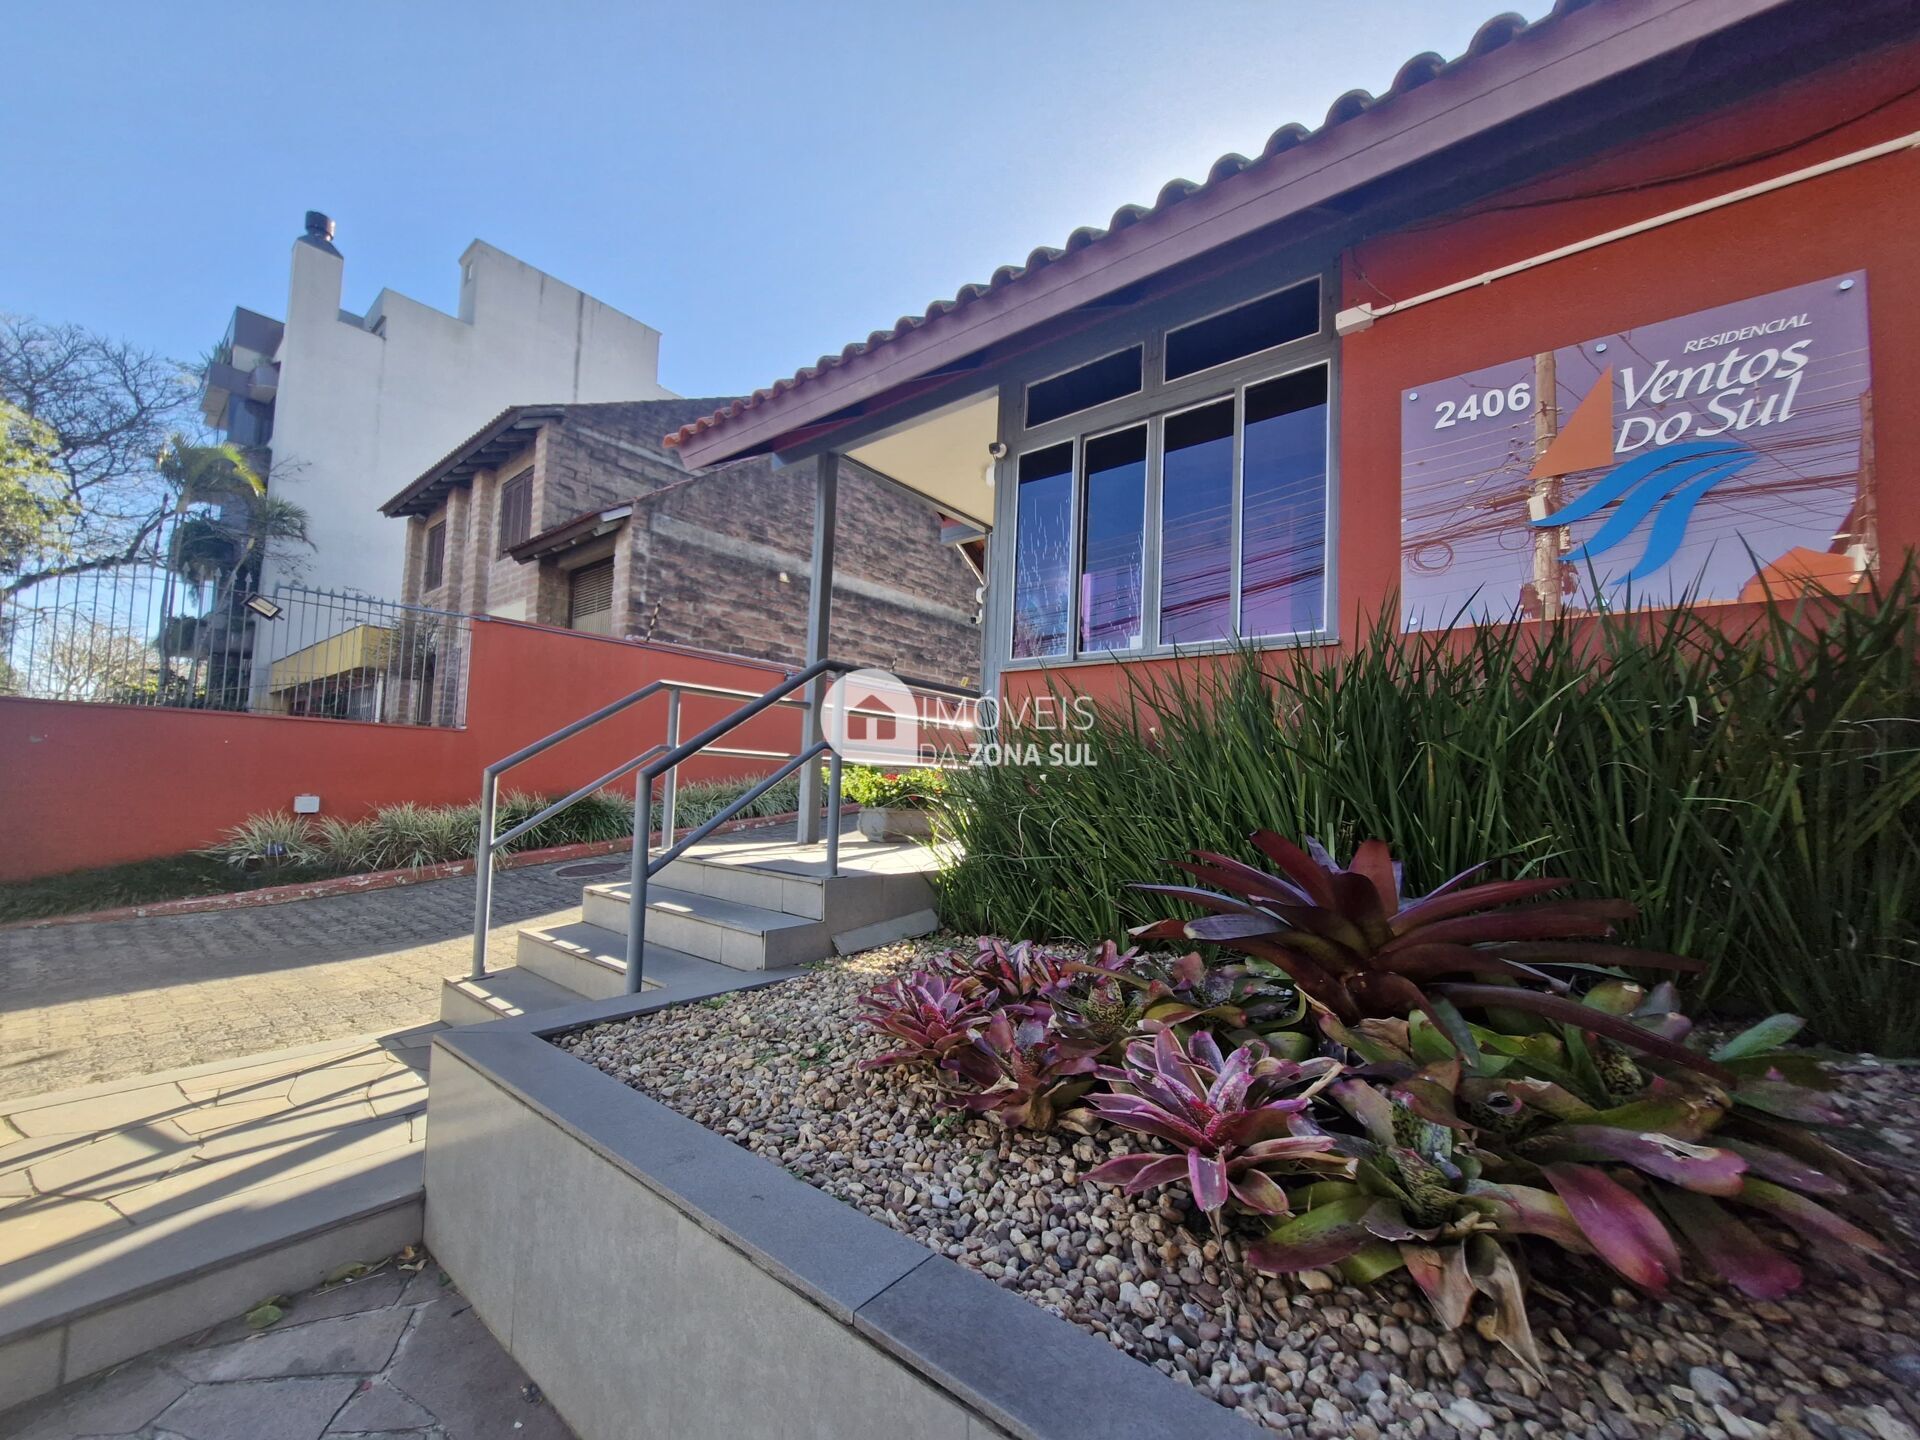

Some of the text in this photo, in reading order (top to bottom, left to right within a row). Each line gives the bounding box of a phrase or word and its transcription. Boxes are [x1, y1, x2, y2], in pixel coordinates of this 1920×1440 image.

[1684, 313, 1811, 354] RESIDENCIAL
[1620, 338, 1812, 410] Ventos
[1434, 382, 1531, 430] 2406
[1697, 371, 1804, 436] Sul
